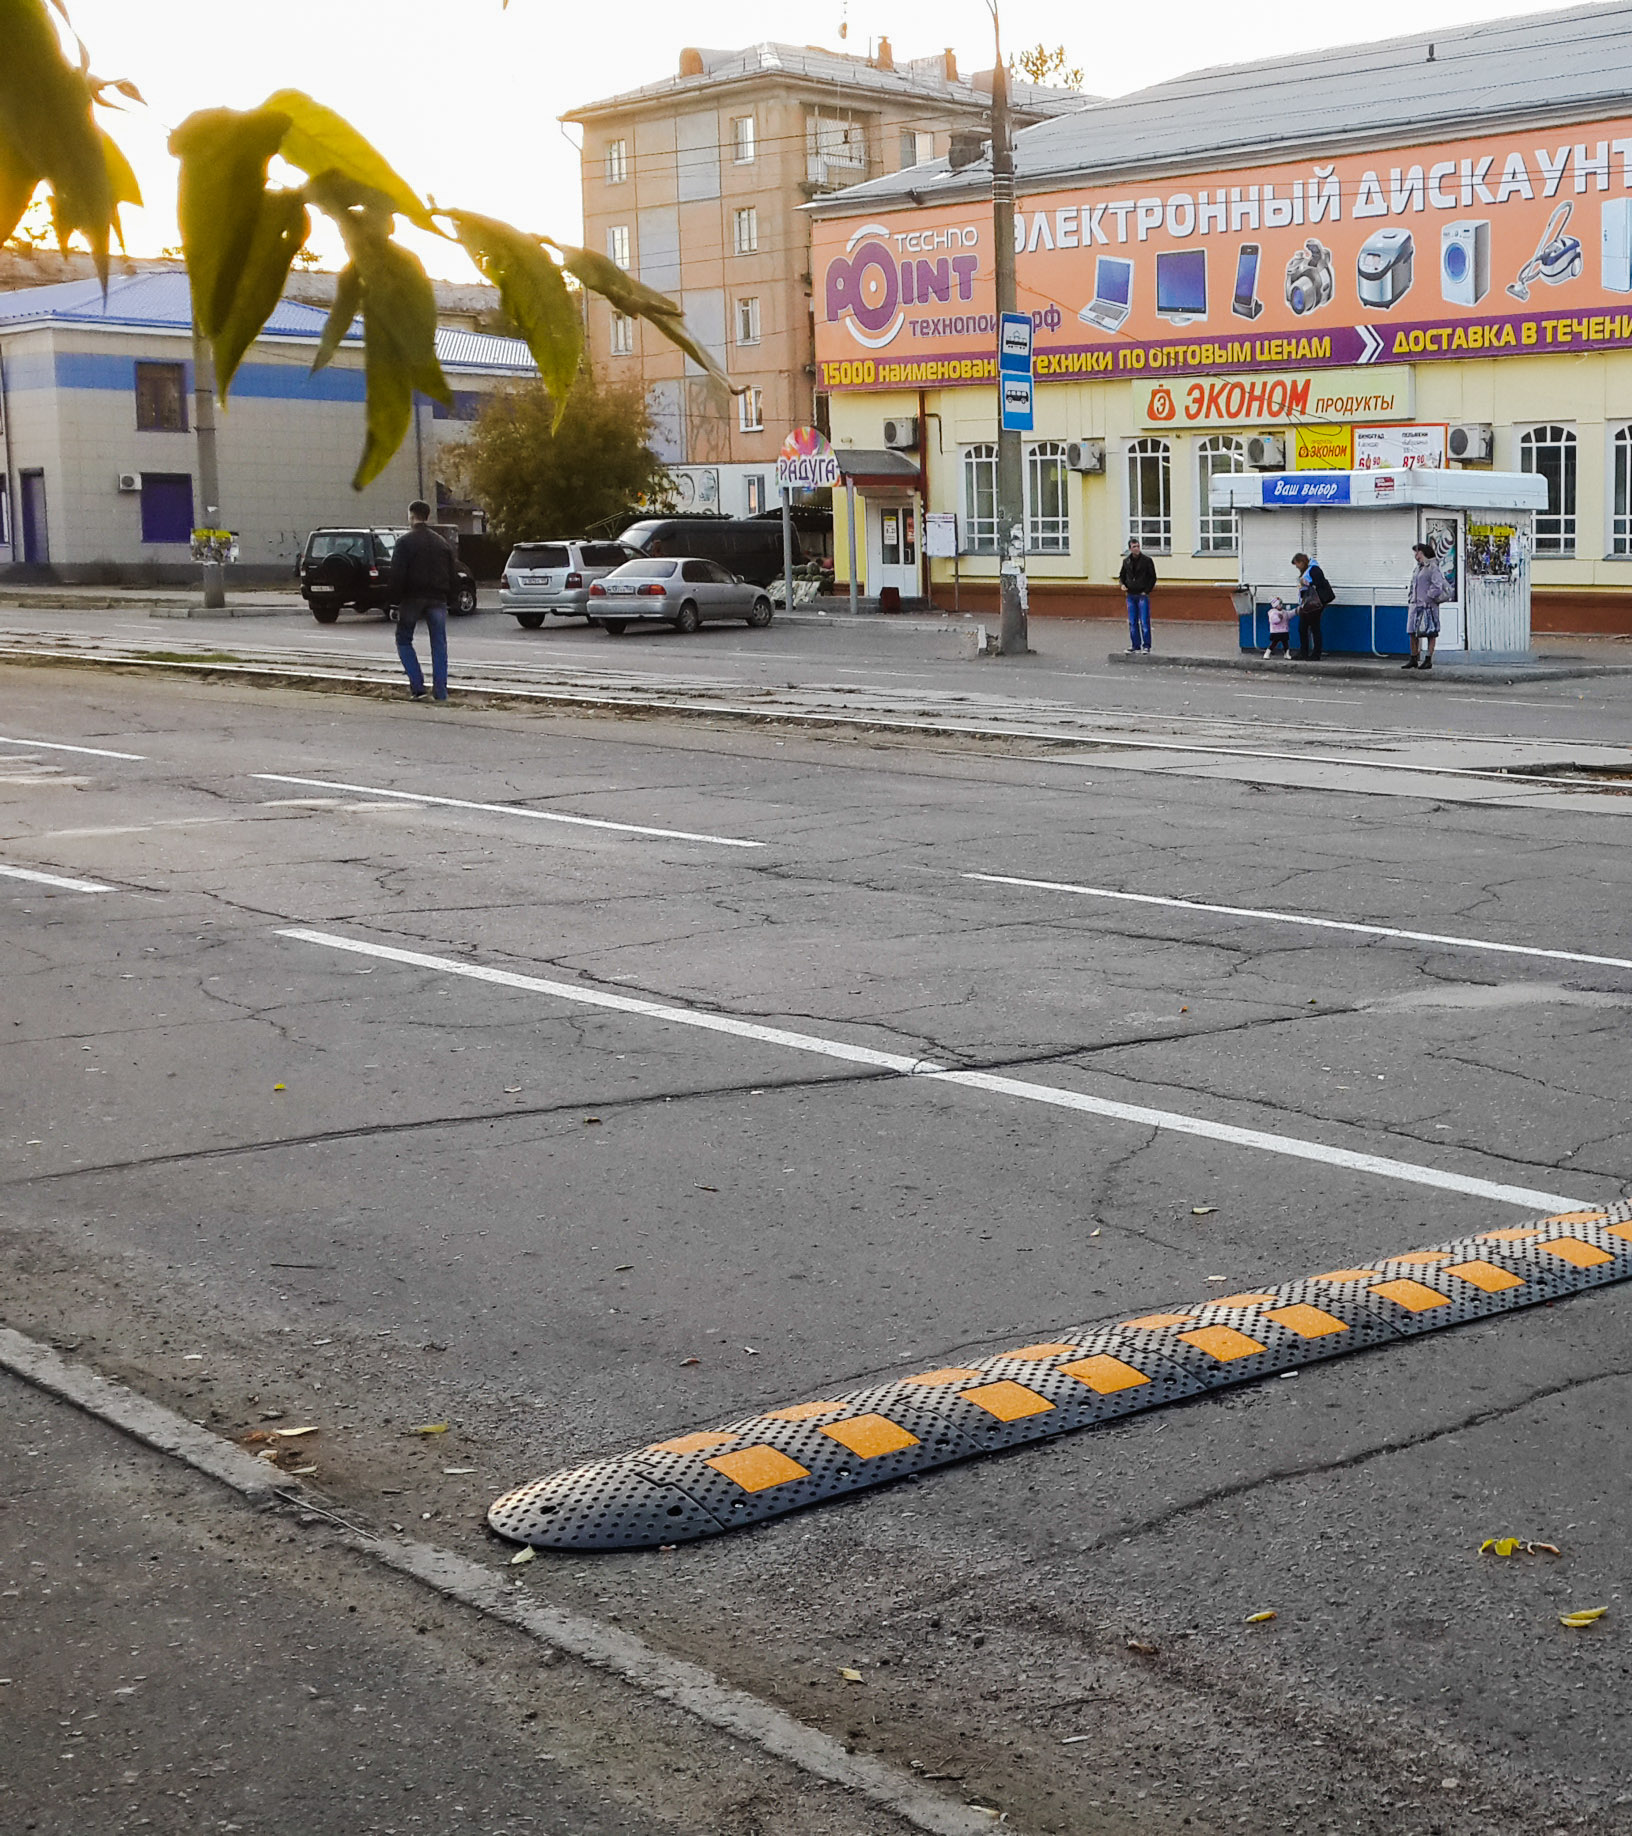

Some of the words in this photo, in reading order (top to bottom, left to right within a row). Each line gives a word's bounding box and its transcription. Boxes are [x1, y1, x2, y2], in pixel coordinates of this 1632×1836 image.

[893, 226, 979, 253] TECHNO
[825, 240, 979, 331] POINT
[1391, 321, 1518, 355] ДОСТАВКА
[1522, 320, 1538, 346] В
[821, 360, 876, 386] 15000
[1119, 348, 1146, 371] ПО
[1148, 340, 1251, 367] ОПТОВЫМ
[1255, 335, 1332, 363] ЦЕНАМ
[1184, 378, 1312, 421] ЭКОНОМ
[1314, 394, 1395, 417] ПРОДУКТЫ
[1310, 445, 1348, 458] ЭКОНОМ
[779, 456, 836, 483] РАДУГА
[1274, 480, 1300, 496] Ваш
[1300, 480, 1338, 498] выбор
